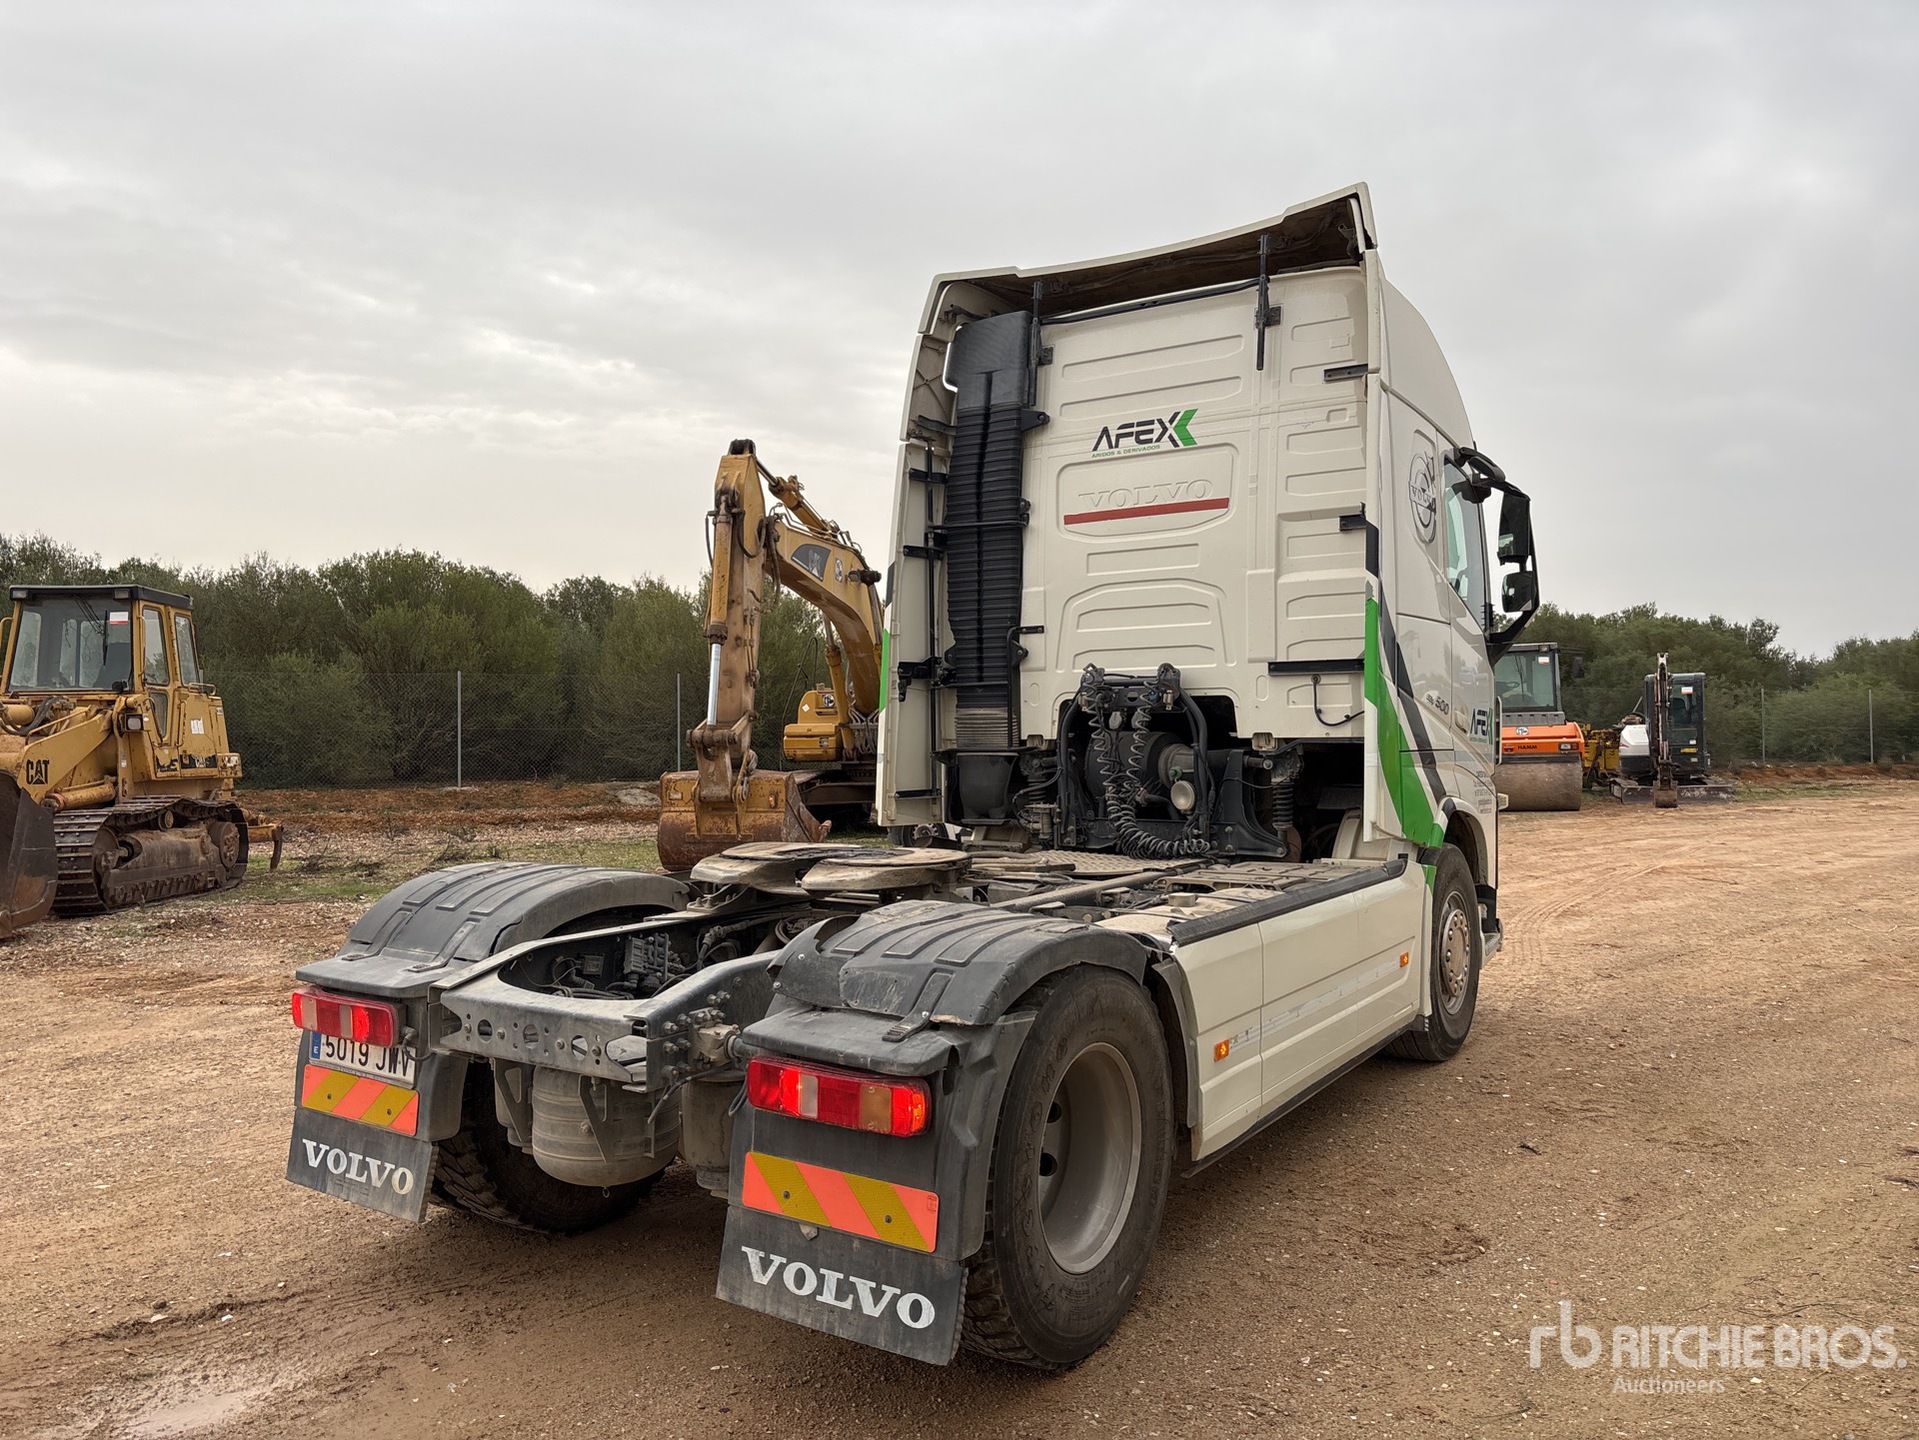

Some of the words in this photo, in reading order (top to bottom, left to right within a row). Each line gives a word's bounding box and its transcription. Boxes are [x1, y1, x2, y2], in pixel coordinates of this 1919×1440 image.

[1123, 444, 1161, 455] DERIVADOS
[1078, 478, 1213, 508] VOLVO
[1435, 695, 1450, 715] 500
[26, 759, 50, 785] CAT
[313, 1046, 319, 1054] E
[325, 1035, 369, 1067] 5019
[375, 1046, 410, 1077] JWV
[302, 1138, 414, 1195] VOLVO
[741, 1245, 936, 1329] VOLVO
